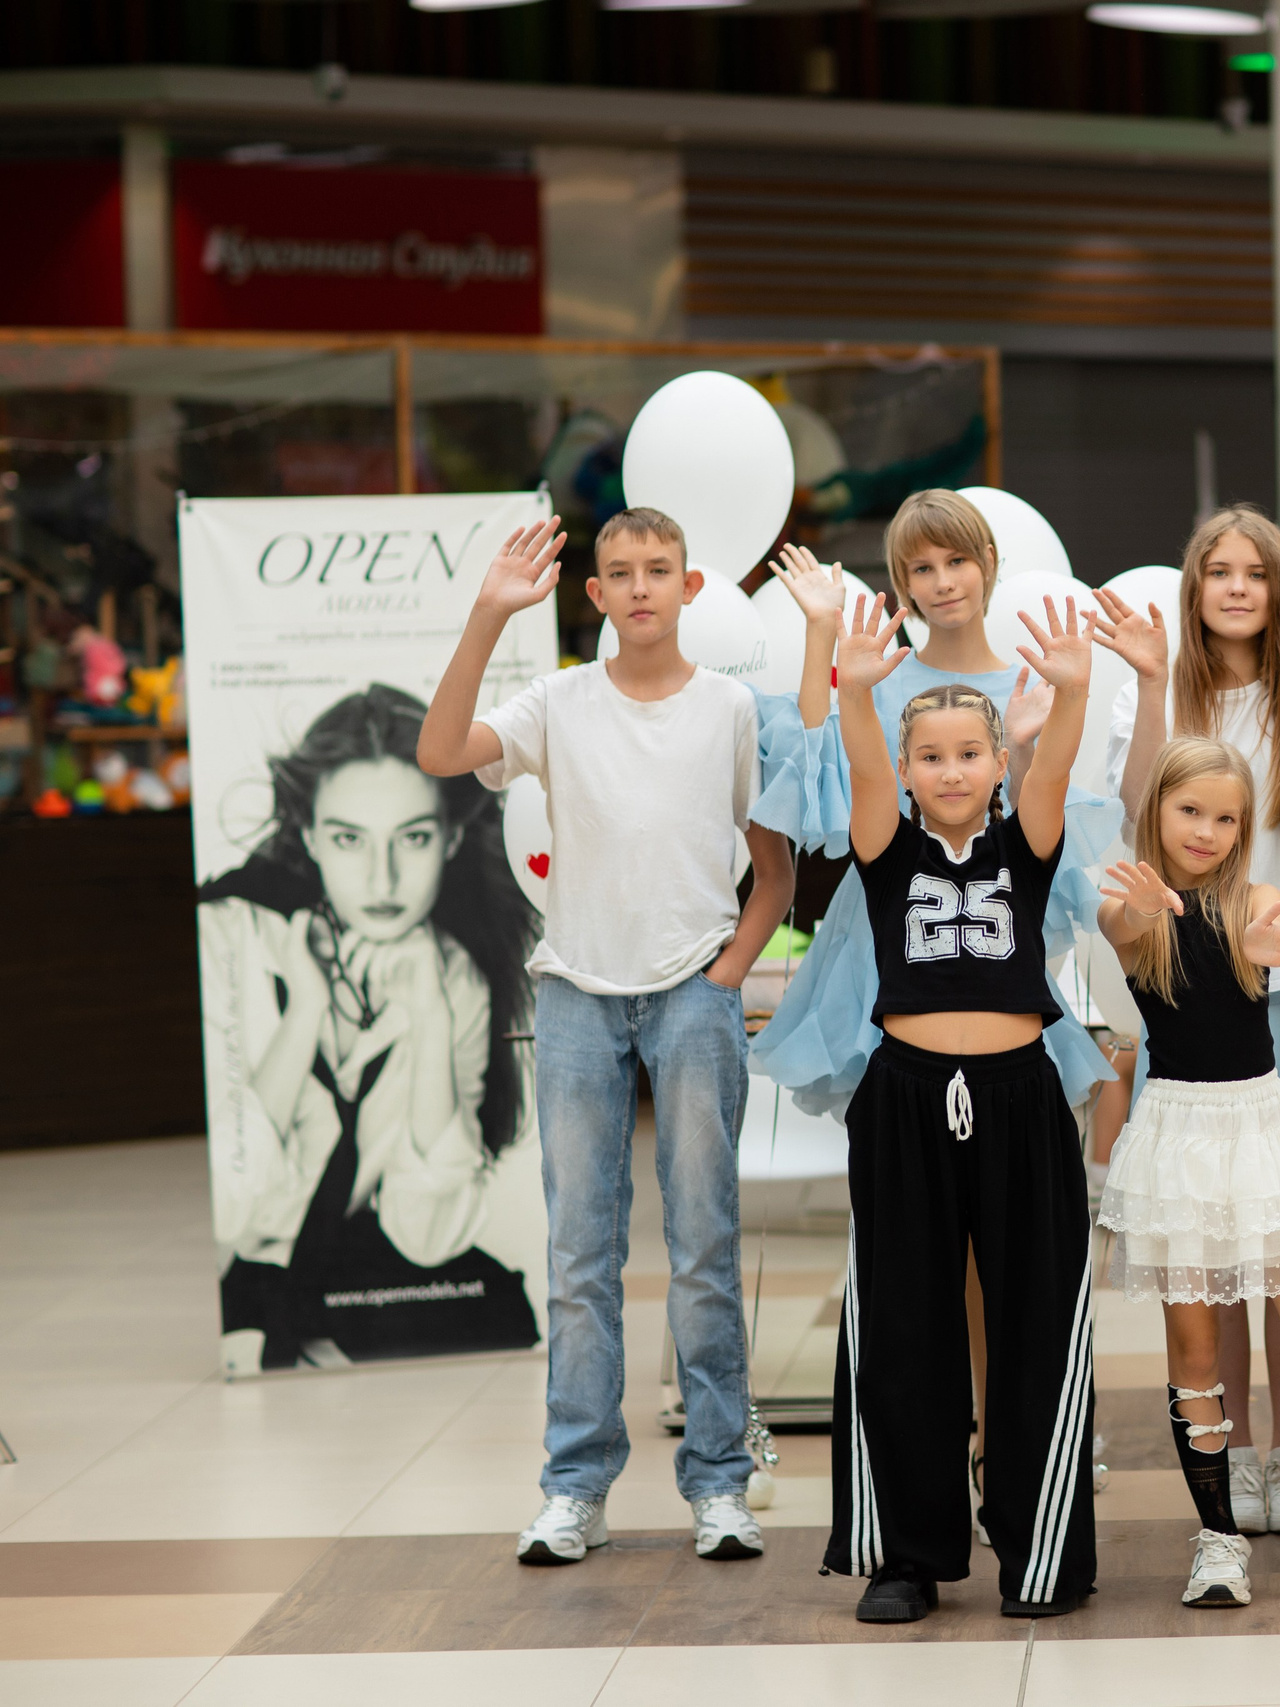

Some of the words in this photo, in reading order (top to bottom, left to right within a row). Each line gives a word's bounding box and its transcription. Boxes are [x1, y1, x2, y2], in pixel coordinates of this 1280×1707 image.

[258, 521, 482, 587] OPEN
[905, 868, 1015, 964] 25
[324, 1280, 485, 1307] www.openmodels.net
